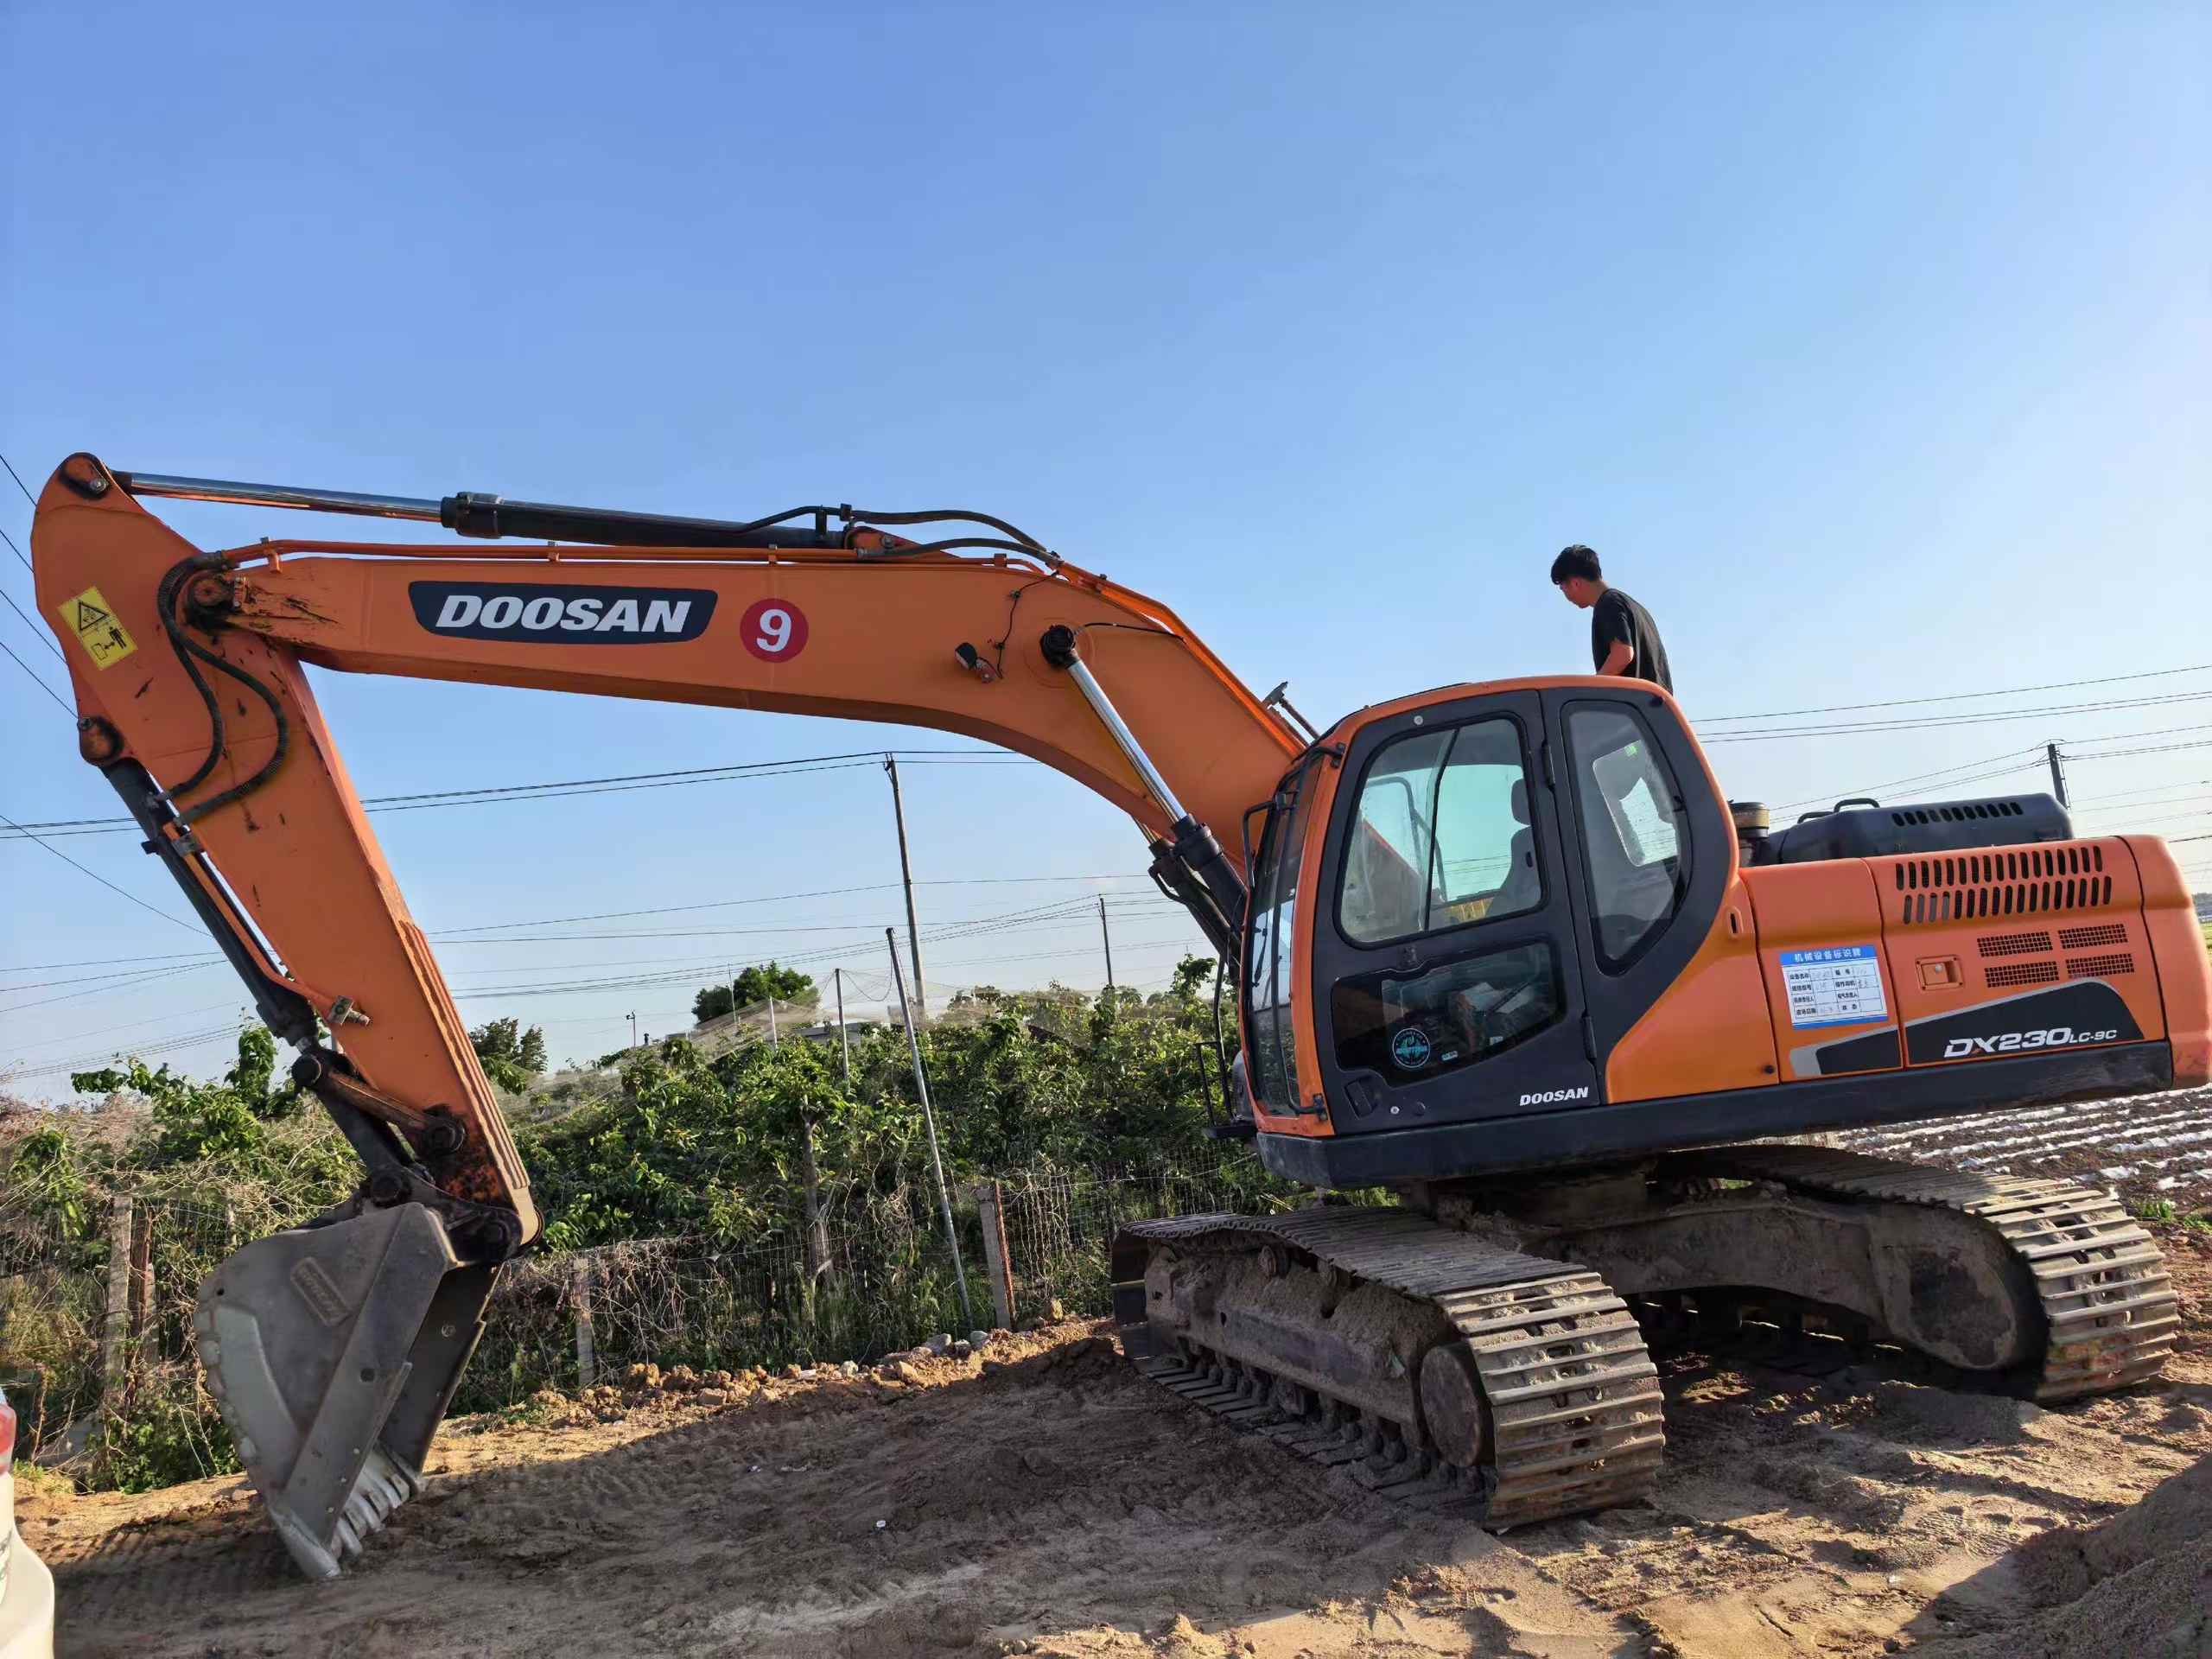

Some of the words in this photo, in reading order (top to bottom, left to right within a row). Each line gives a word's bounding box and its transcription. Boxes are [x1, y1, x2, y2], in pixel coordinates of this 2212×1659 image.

[435, 594, 691, 632] DOOSAN
[756, 609, 791, 652] 9
[1519, 1086, 1589, 1106] DOOSAN
